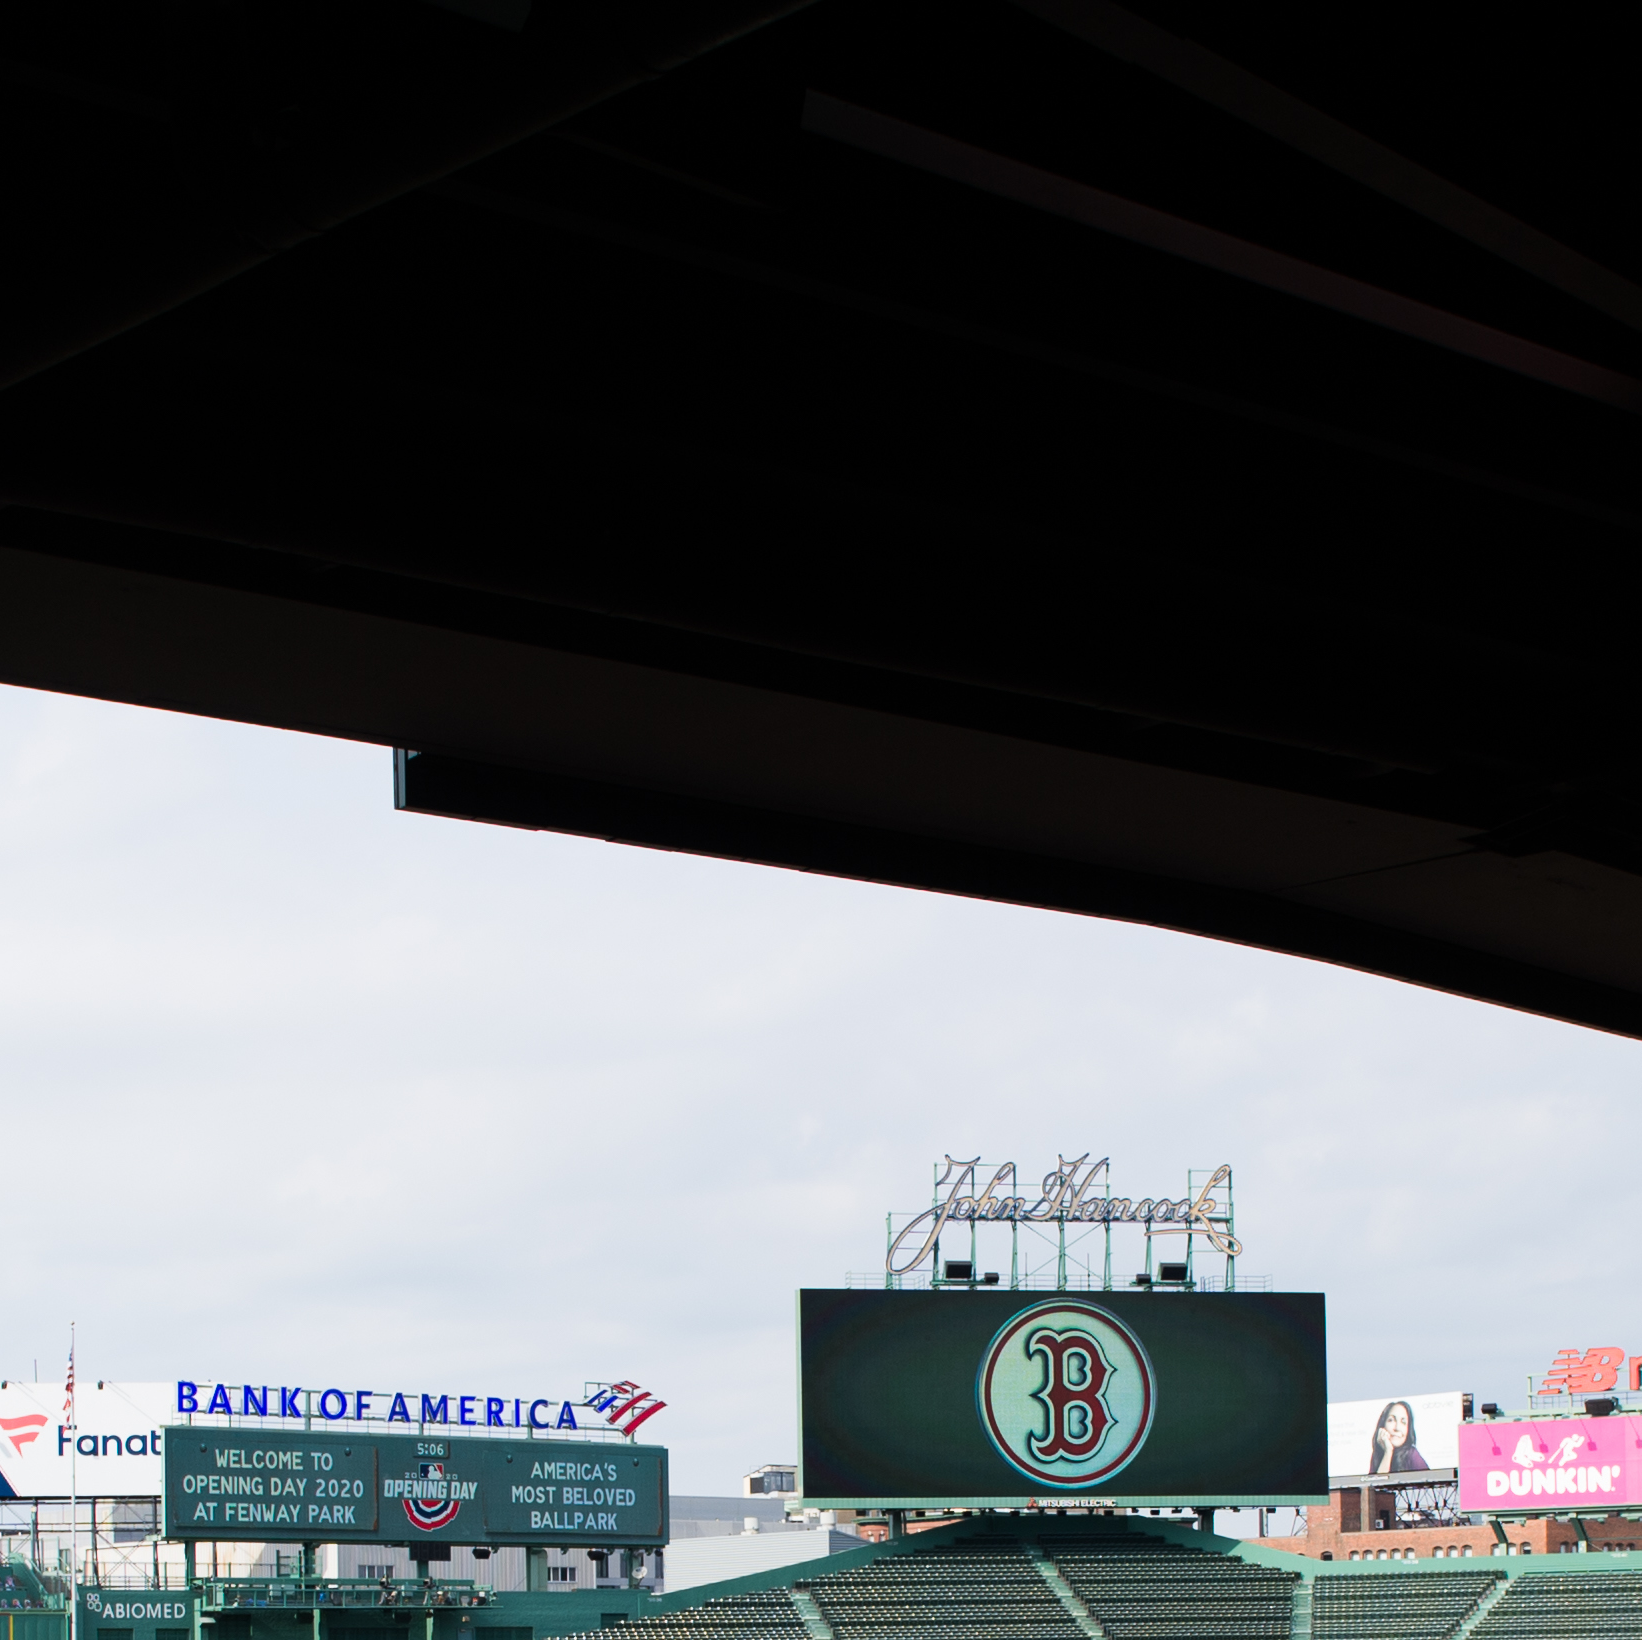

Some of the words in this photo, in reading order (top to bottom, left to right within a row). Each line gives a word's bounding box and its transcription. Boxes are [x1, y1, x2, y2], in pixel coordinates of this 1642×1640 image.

[886, 1154, 1028, 1276] John
[1028, 1153, 1242, 1256] Hancock
[1027, 1327, 1118, 1462] B
[178, 1382, 303, 1418] BANK
[319, 1389, 373, 1421] OF
[387, 1392, 579, 1431] AMERICA
[215, 1449, 303, 1471] WELCOME
[311, 1454, 333, 1471] TO
[416, 1443, 444, 1457] 5:06
[531, 1462, 617, 1481] AMERICA'S
[1487, 1465, 1620, 1497] DUNKIN'
[183, 1476, 264, 1496] OPENING
[269, 1478, 307, 1497] DAY
[315, 1479, 364, 1499] 2020
[384, 1480, 448, 1499] OPENING
[450, 1481, 478, 1500] DAY
[512, 1486, 556, 1504] MOST
[562, 1488, 636, 1507] BELOVED
[193, 1502, 218, 1521] AT
[224, 1503, 303, 1523] FENWAY
[308, 1504, 356, 1525] PARK
[531, 1511, 618, 1531] BALLPARK
[104, 1602, 186, 1619] ABIOMED
